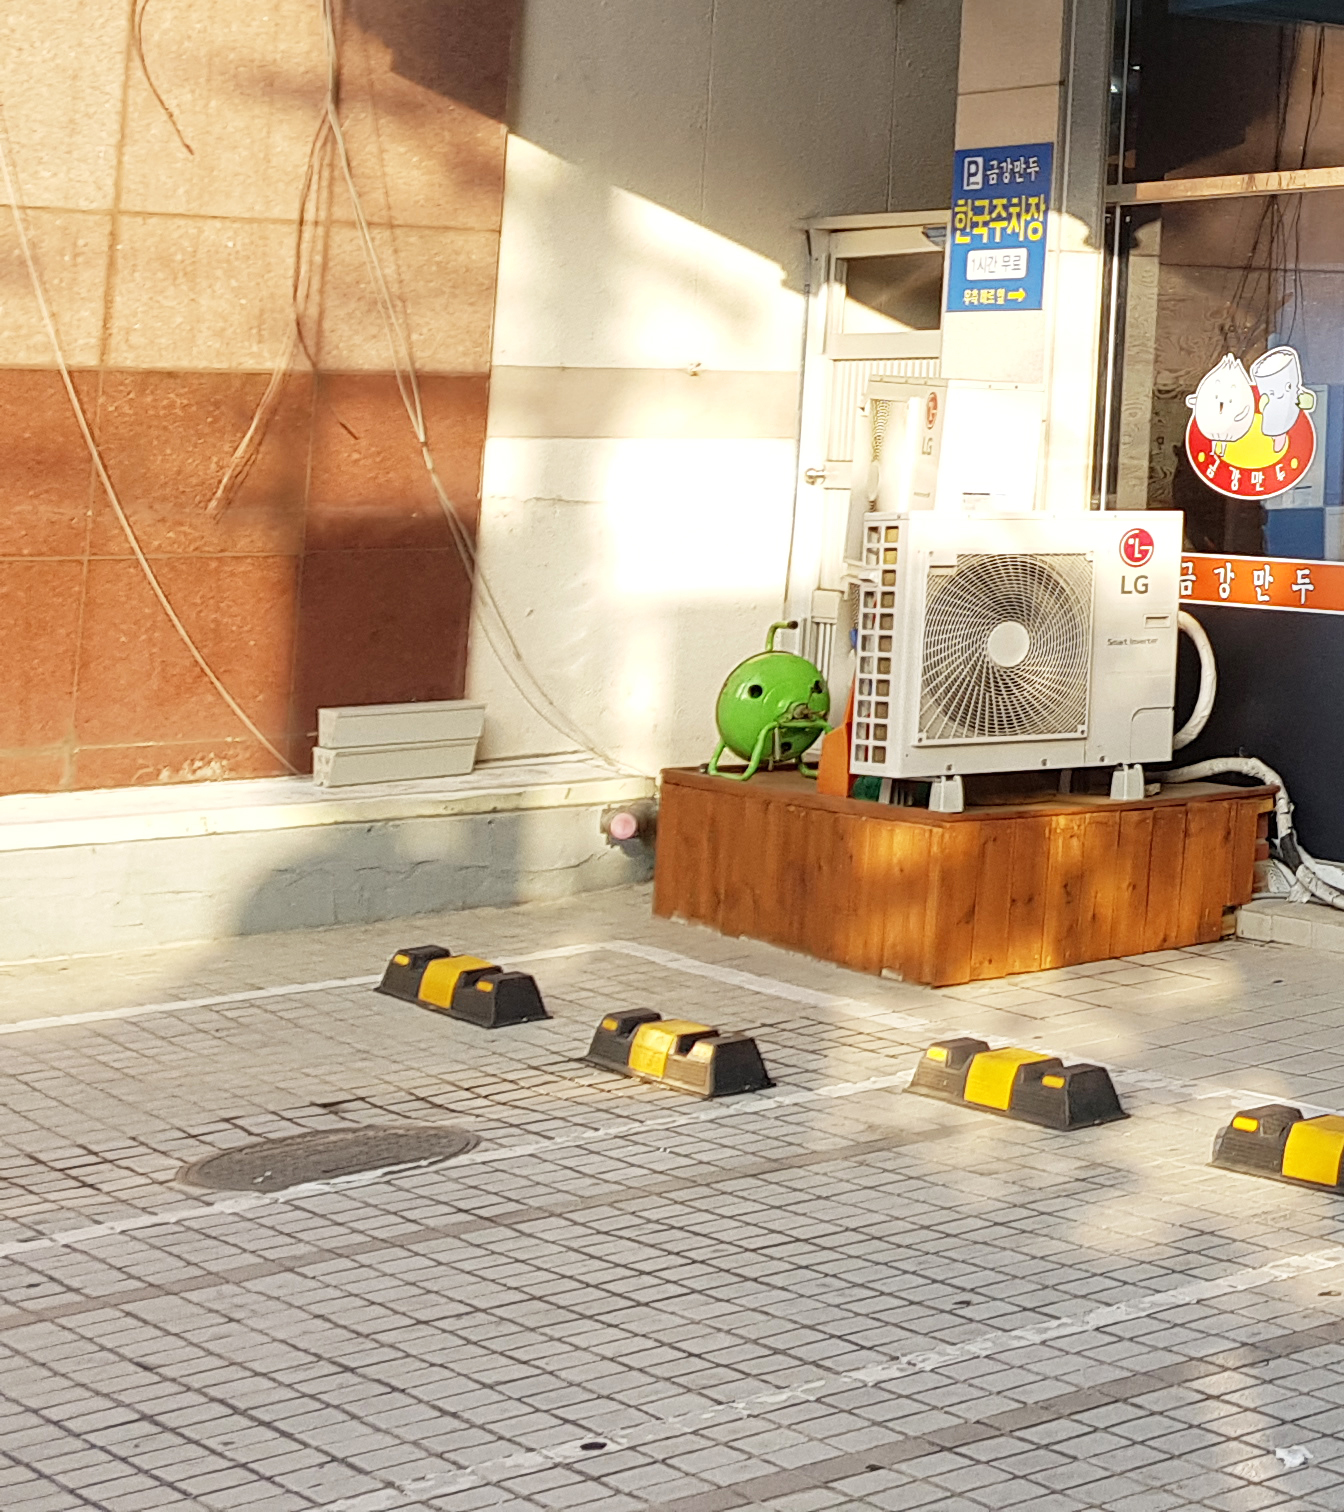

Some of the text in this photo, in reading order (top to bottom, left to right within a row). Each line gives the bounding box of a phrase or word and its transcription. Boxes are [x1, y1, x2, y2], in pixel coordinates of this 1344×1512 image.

[987, 157, 1040, 185] 금강만두
[954, 194, 1046, 244] 한국주차장
[1120, 575, 1149, 594] LG
